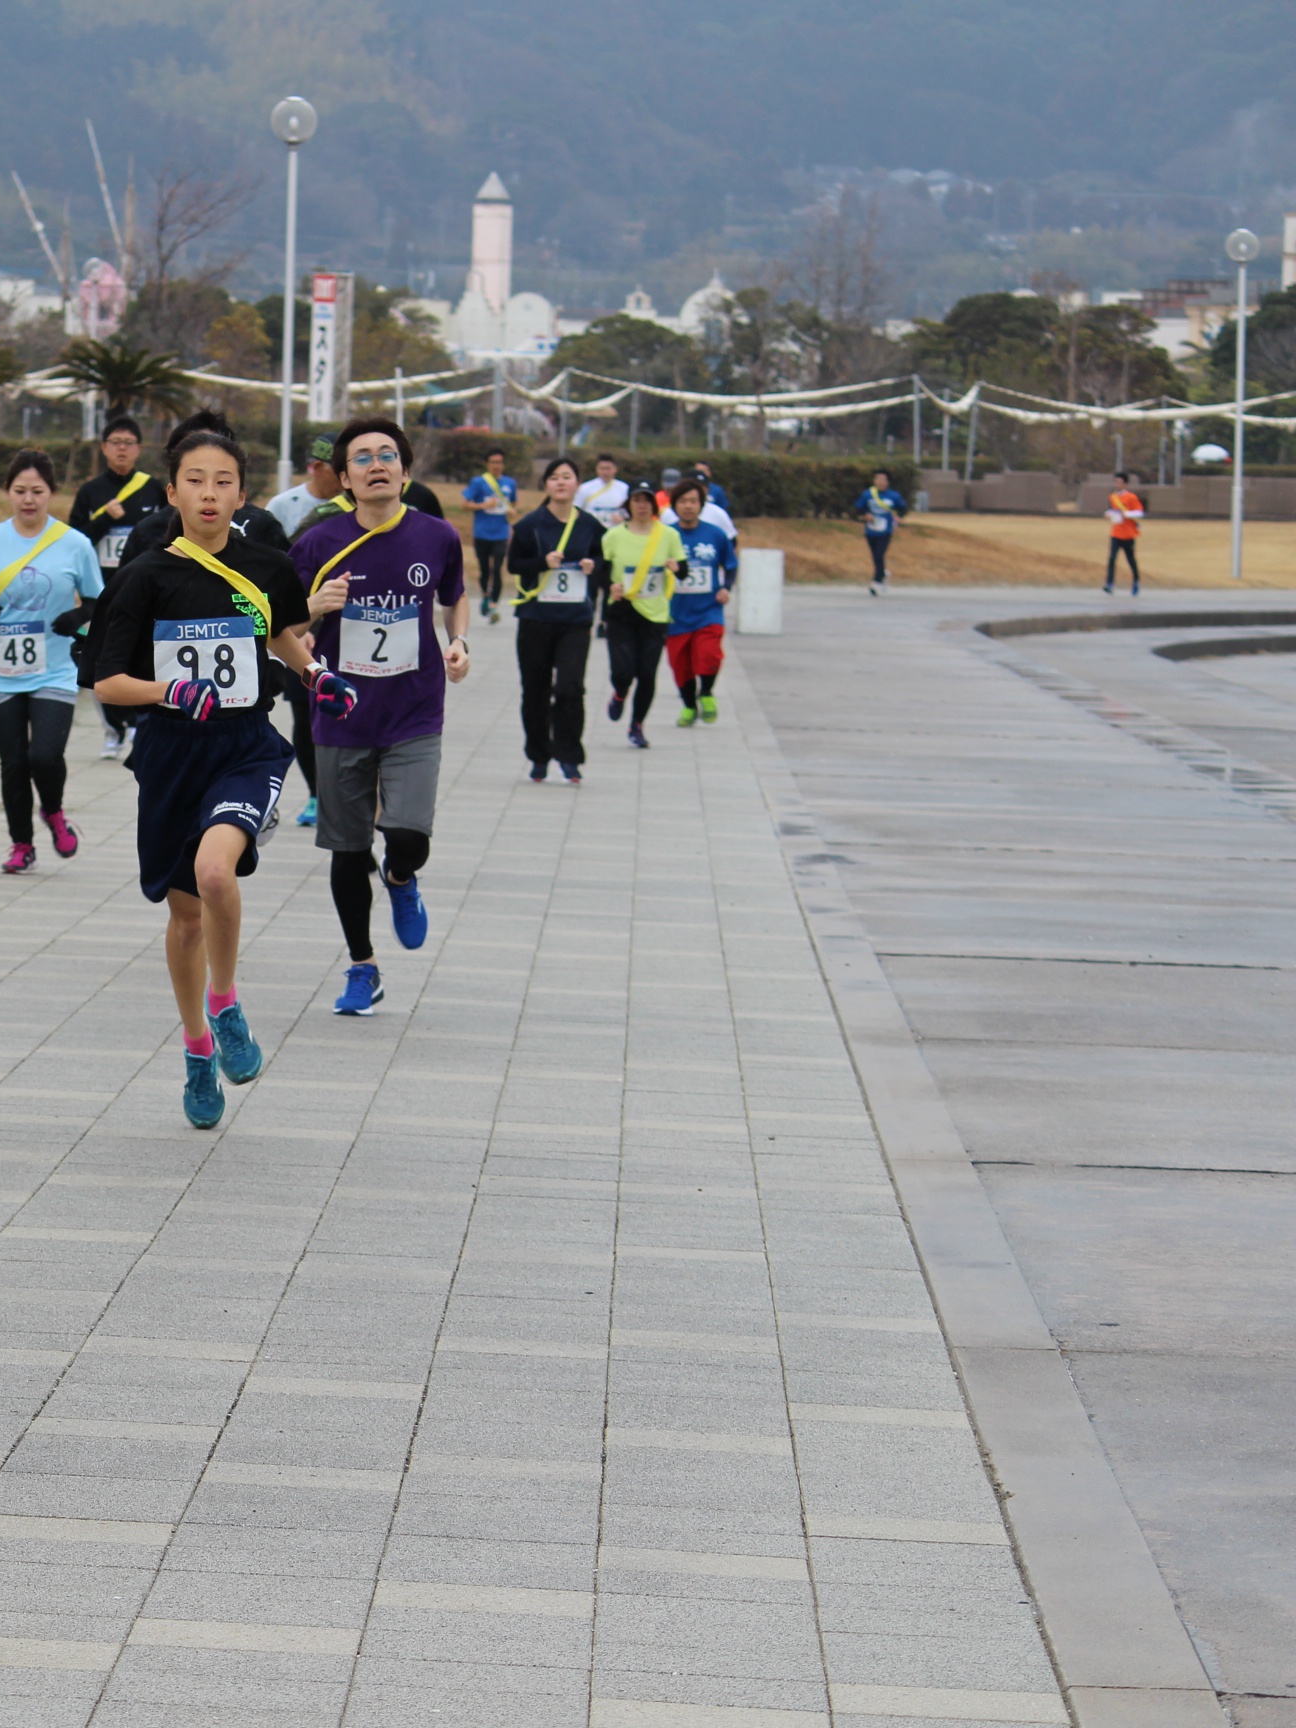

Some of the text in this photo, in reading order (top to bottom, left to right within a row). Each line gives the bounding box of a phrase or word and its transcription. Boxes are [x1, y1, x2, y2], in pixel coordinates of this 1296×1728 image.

[558, 572, 568, 593] 8
[361, 610, 400, 623] JEMTC
[176, 622, 229, 639] JEMTC
[371, 627, 388, 663] 2
[177, 643, 236, 689] 98
